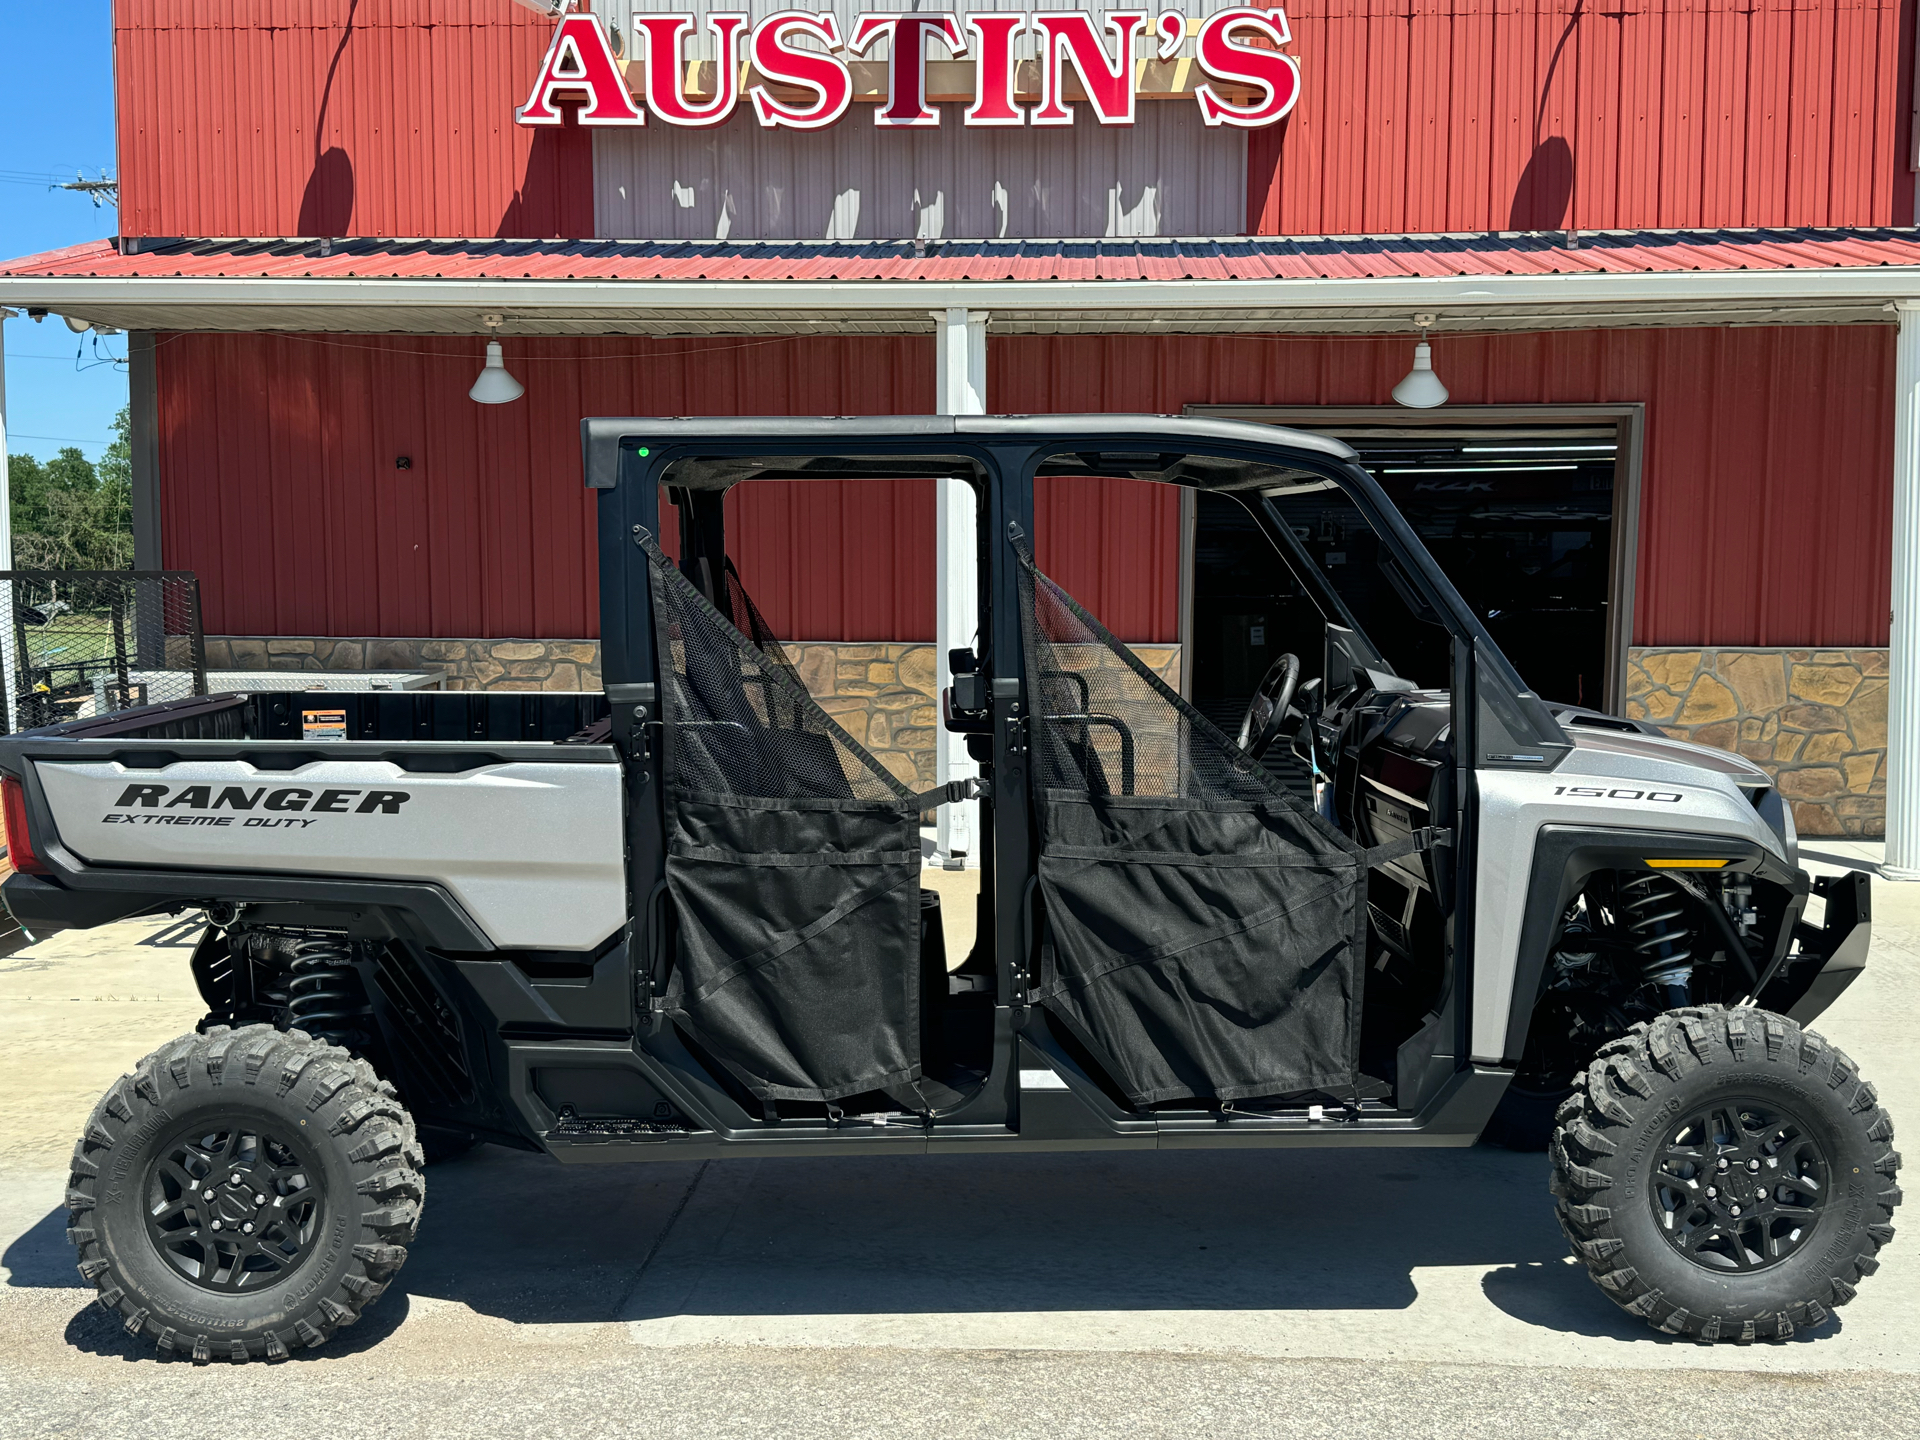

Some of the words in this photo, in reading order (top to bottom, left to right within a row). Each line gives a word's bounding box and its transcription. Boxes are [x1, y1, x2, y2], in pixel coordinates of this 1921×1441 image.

[114, 783, 411, 814] RANGER
[1554, 786, 1683, 803] 1500
[101, 813, 236, 827] EXTREME
[242, 818, 318, 828] DUTY
[105, 1110, 173, 1205] X-TERRAIN
[1804, 1182, 1866, 1284] X-TERRAIN
[296, 1248, 338, 1300] ARMOR
